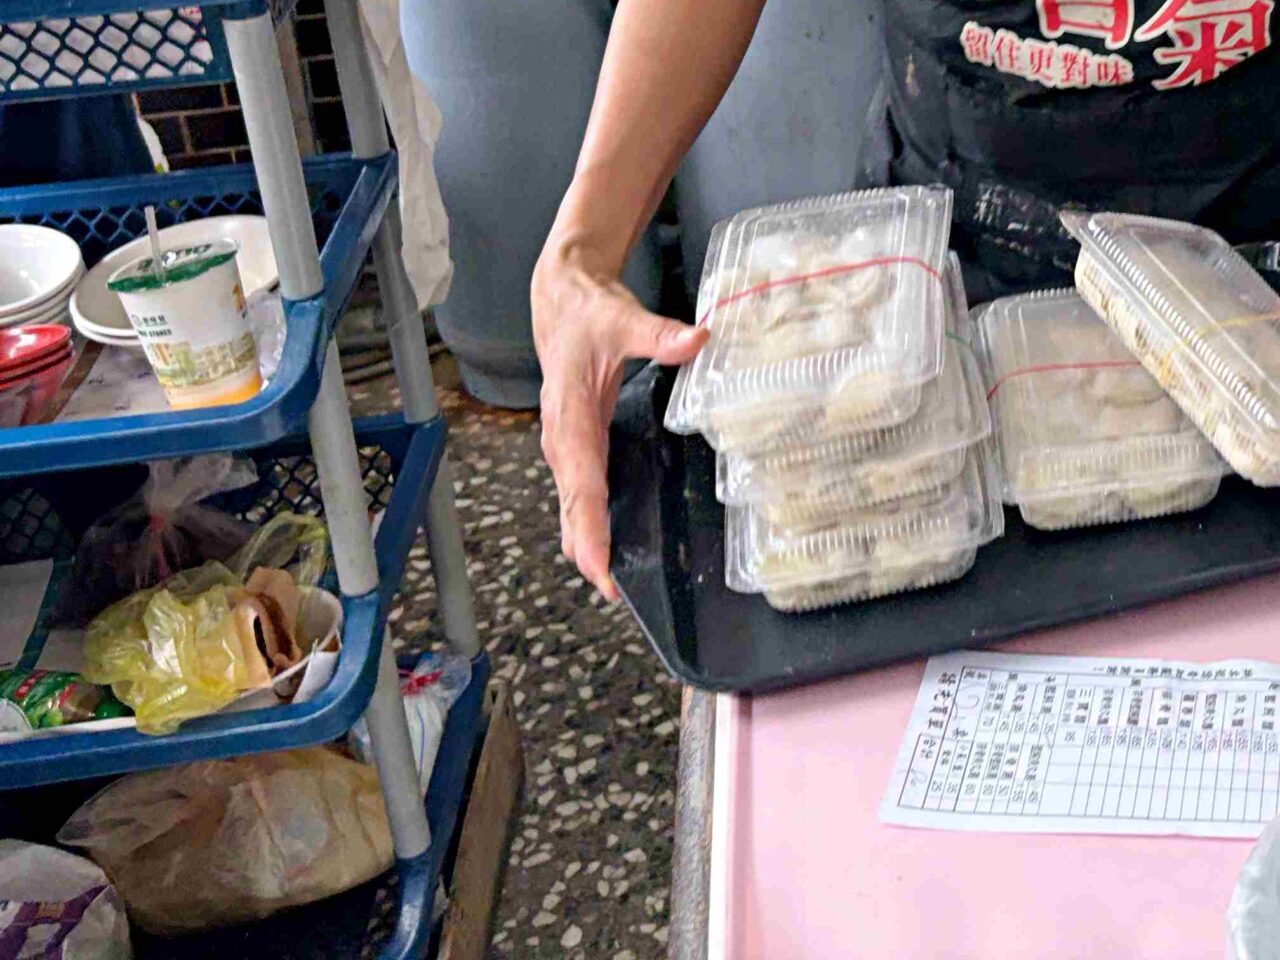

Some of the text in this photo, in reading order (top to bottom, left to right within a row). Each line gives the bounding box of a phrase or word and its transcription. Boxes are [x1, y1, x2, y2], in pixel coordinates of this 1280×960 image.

[962, 23, 1135, 87] 留住更對味
